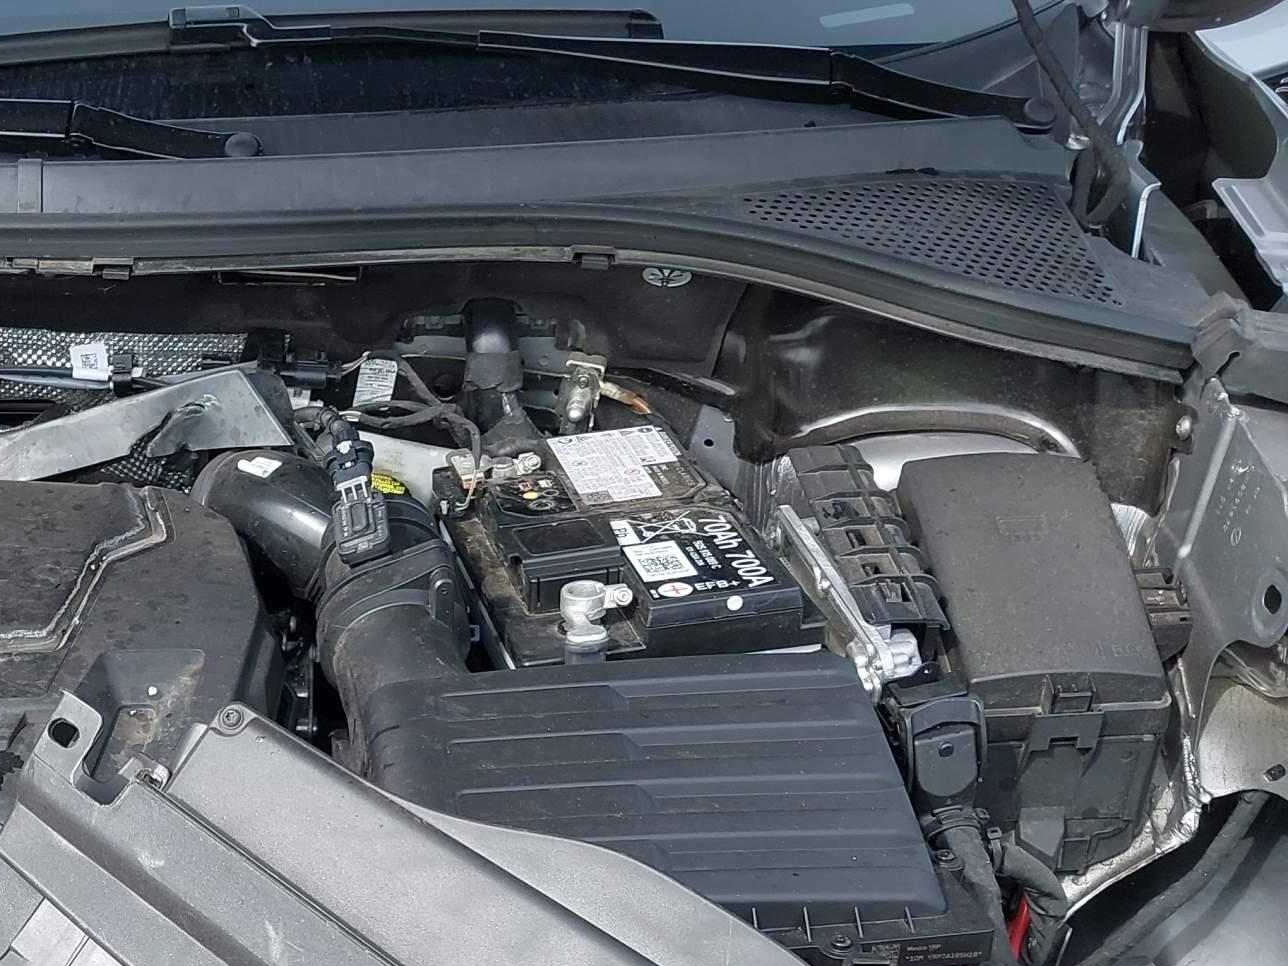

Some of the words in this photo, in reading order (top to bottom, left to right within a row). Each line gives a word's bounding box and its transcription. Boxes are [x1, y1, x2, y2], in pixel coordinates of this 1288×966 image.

[698, 515, 742, 549] 70Ah
[725, 550, 774, 588] 700A
[694, 580, 740, 590] EFB+
